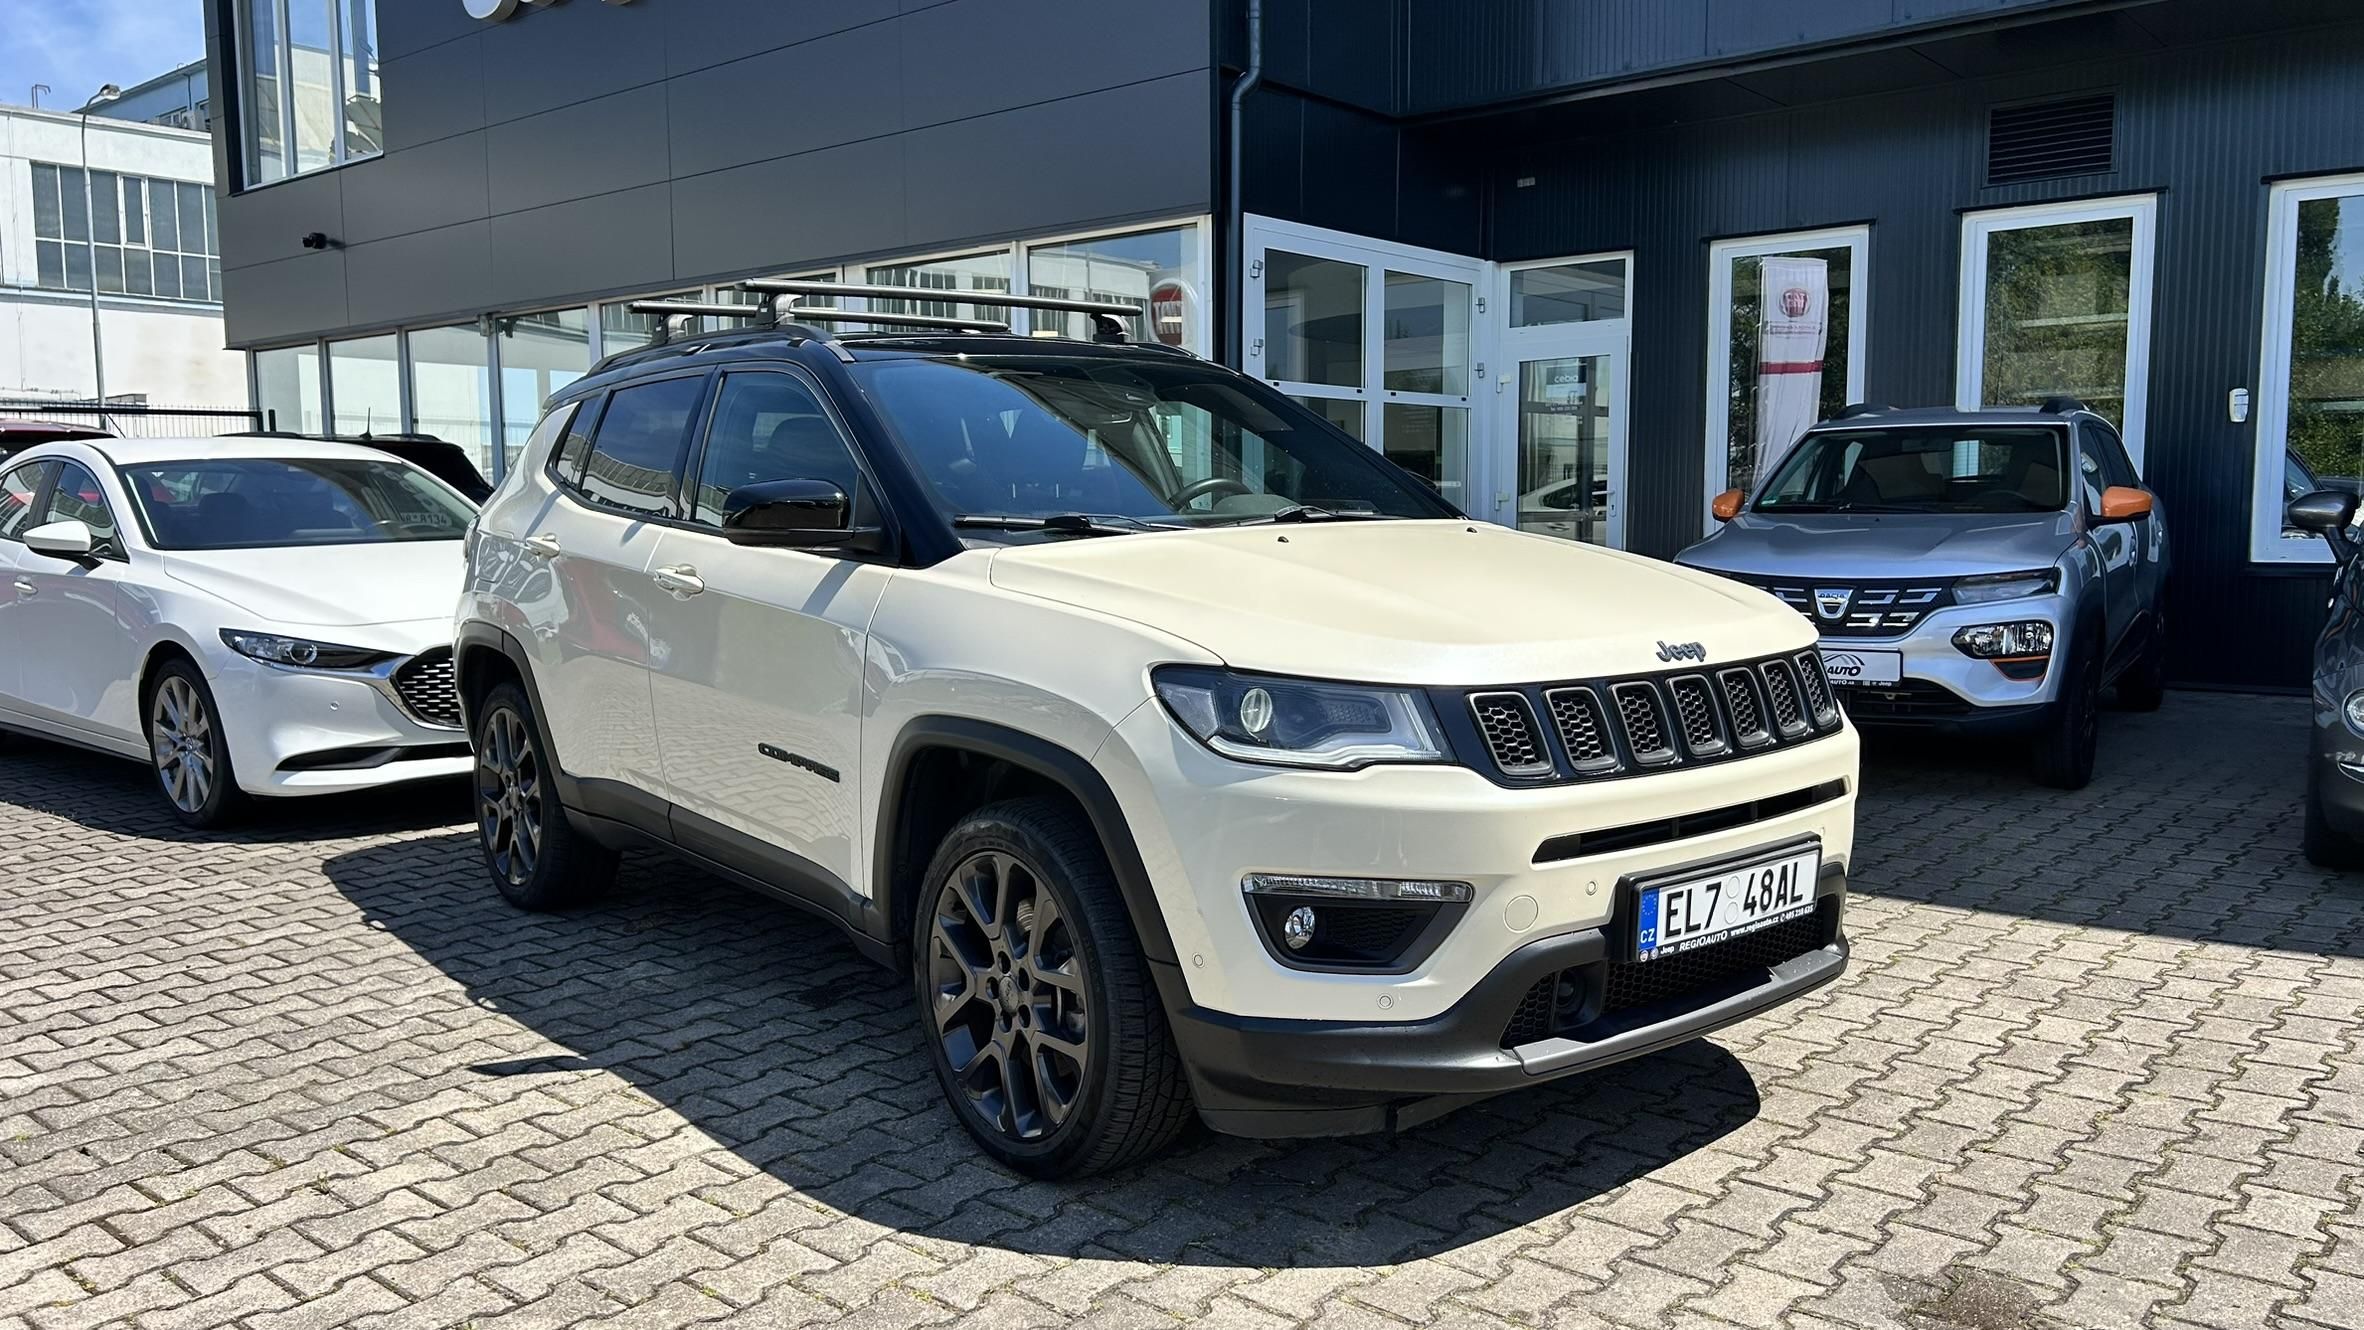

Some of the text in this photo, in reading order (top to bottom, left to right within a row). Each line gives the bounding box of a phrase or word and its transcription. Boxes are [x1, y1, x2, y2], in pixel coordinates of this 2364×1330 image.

[1656, 640, 1706, 662] Jeep
[1664, 861, 1803, 938] EL7 48AL
[1640, 928, 1655, 943] CZ
[1660, 945, 1675, 955] Jeep
[1679, 930, 1728, 951] REGIOAUTO
